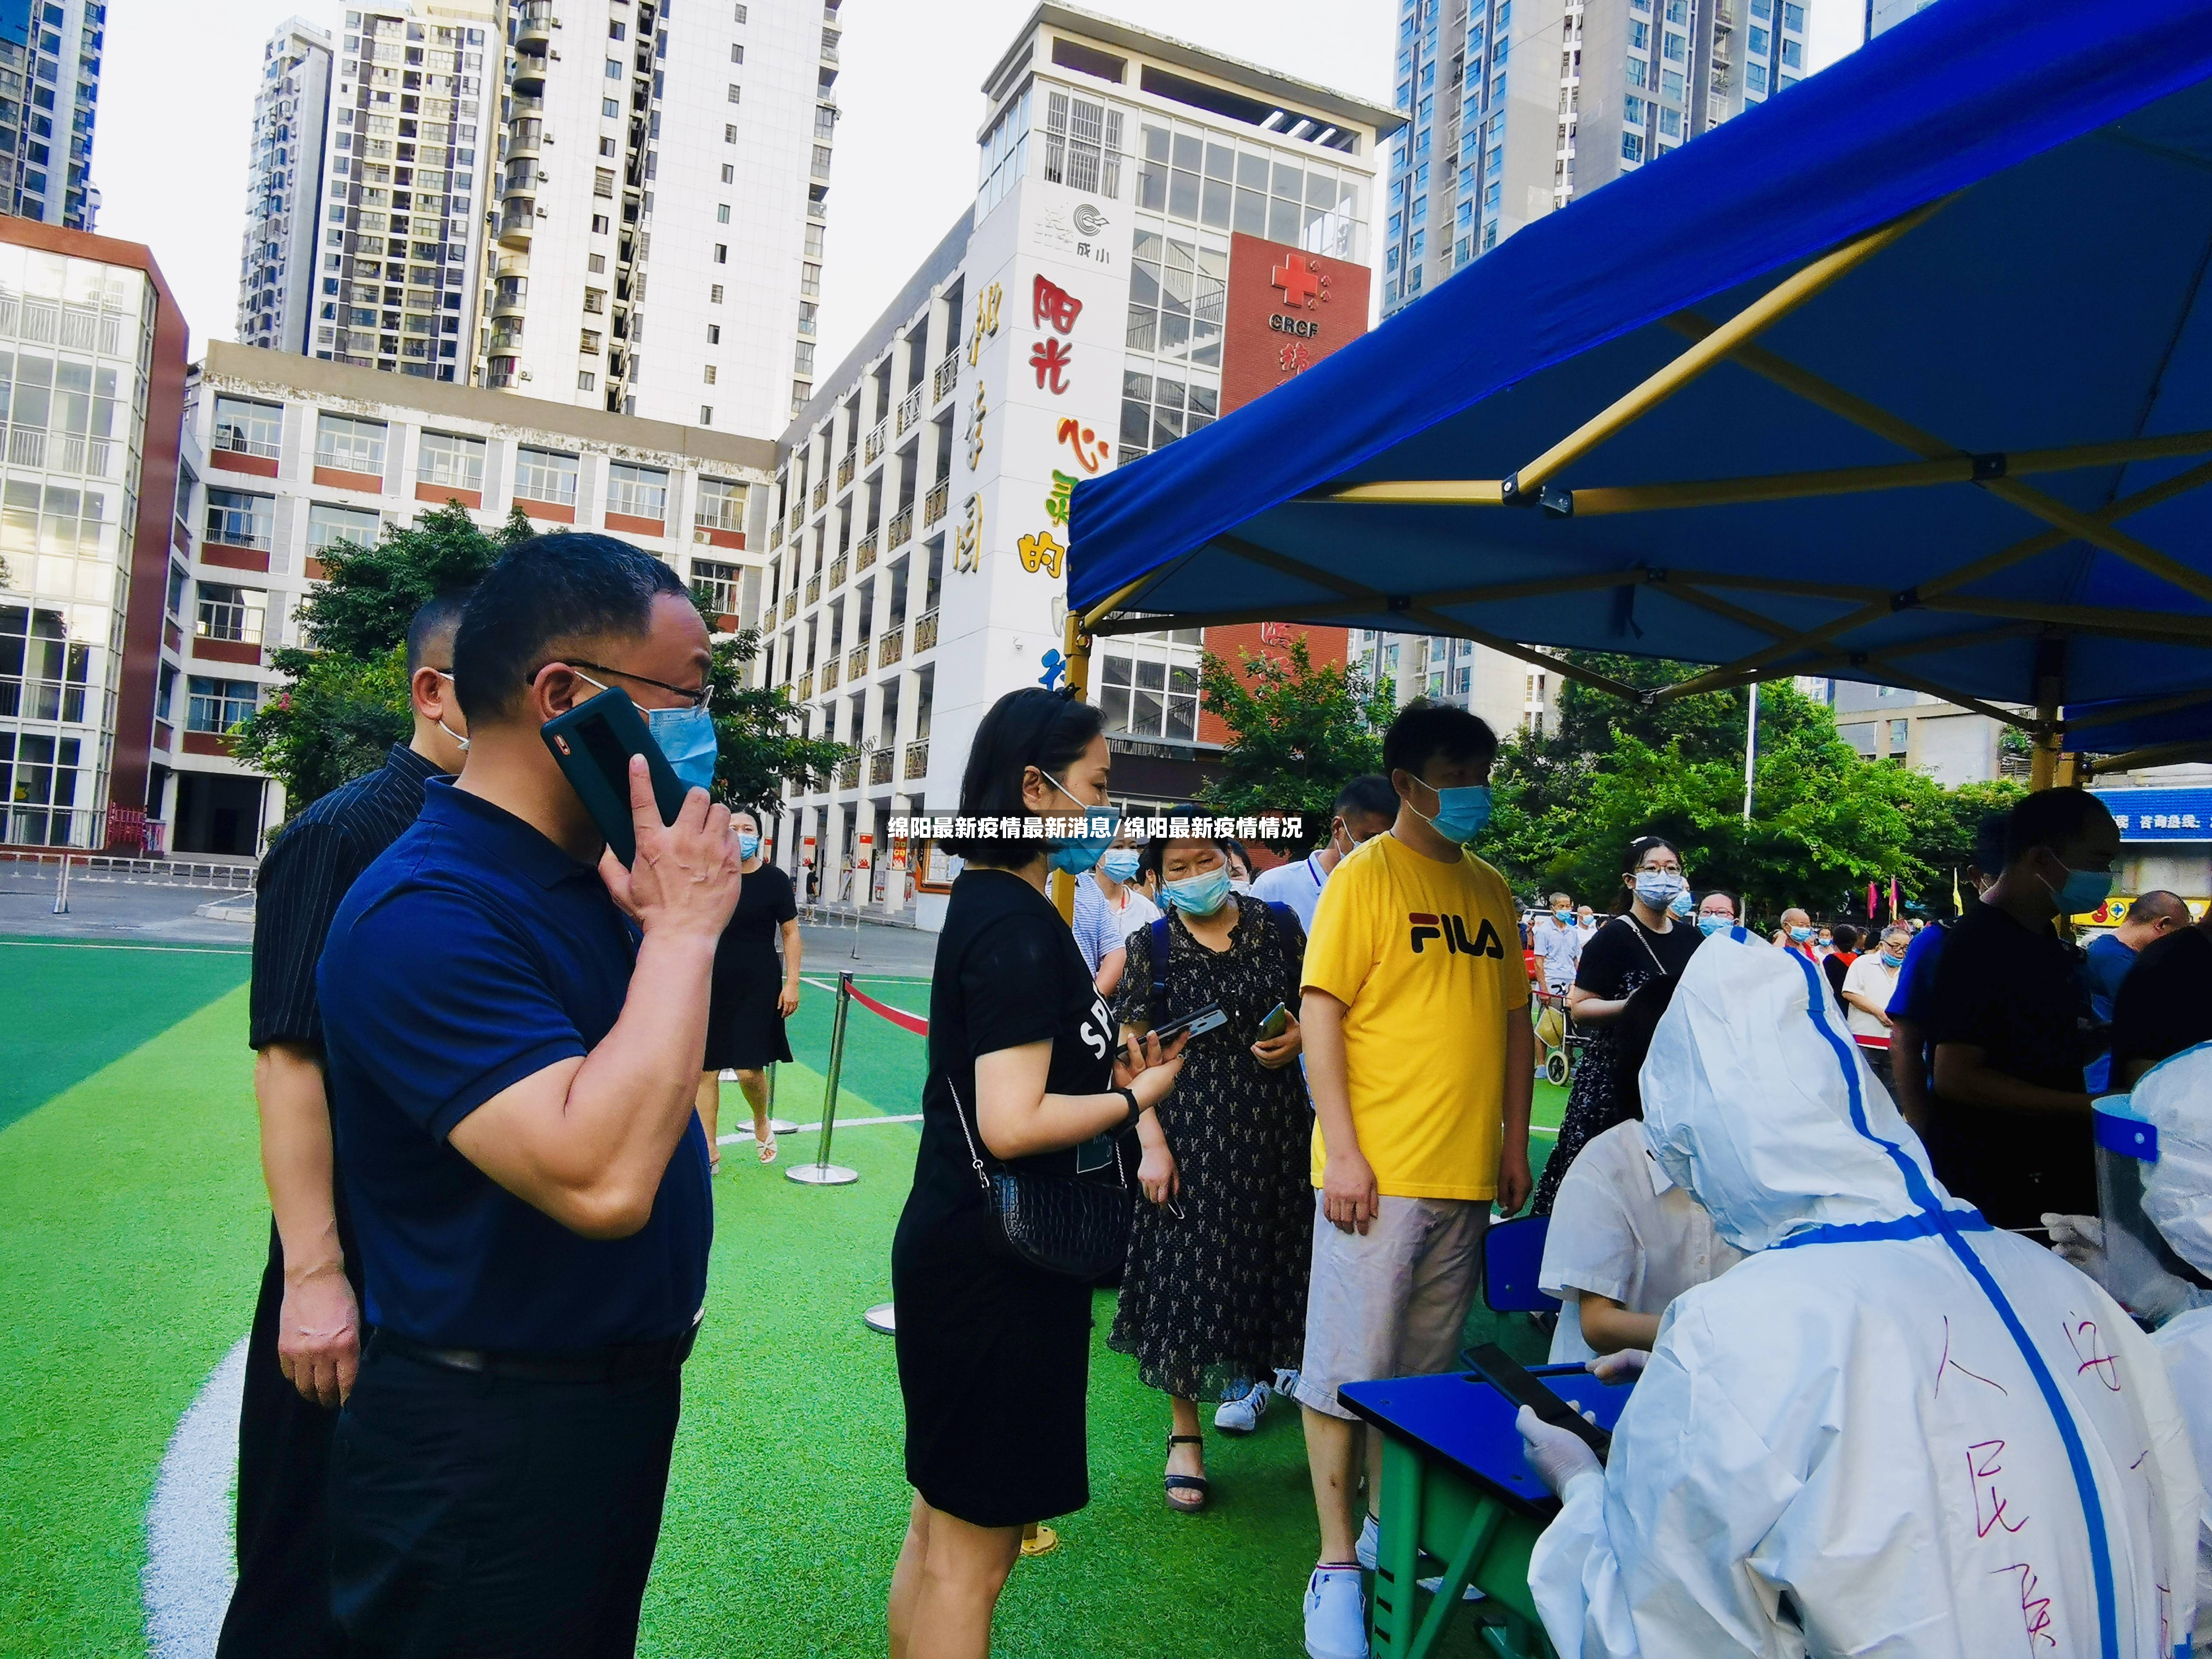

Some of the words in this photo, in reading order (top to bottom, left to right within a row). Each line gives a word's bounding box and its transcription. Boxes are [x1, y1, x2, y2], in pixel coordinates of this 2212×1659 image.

[1269, 314, 1319, 338] CRCF
[1409, 912, 1504, 960] FILA
[1080, 981, 1115, 1060] SP
